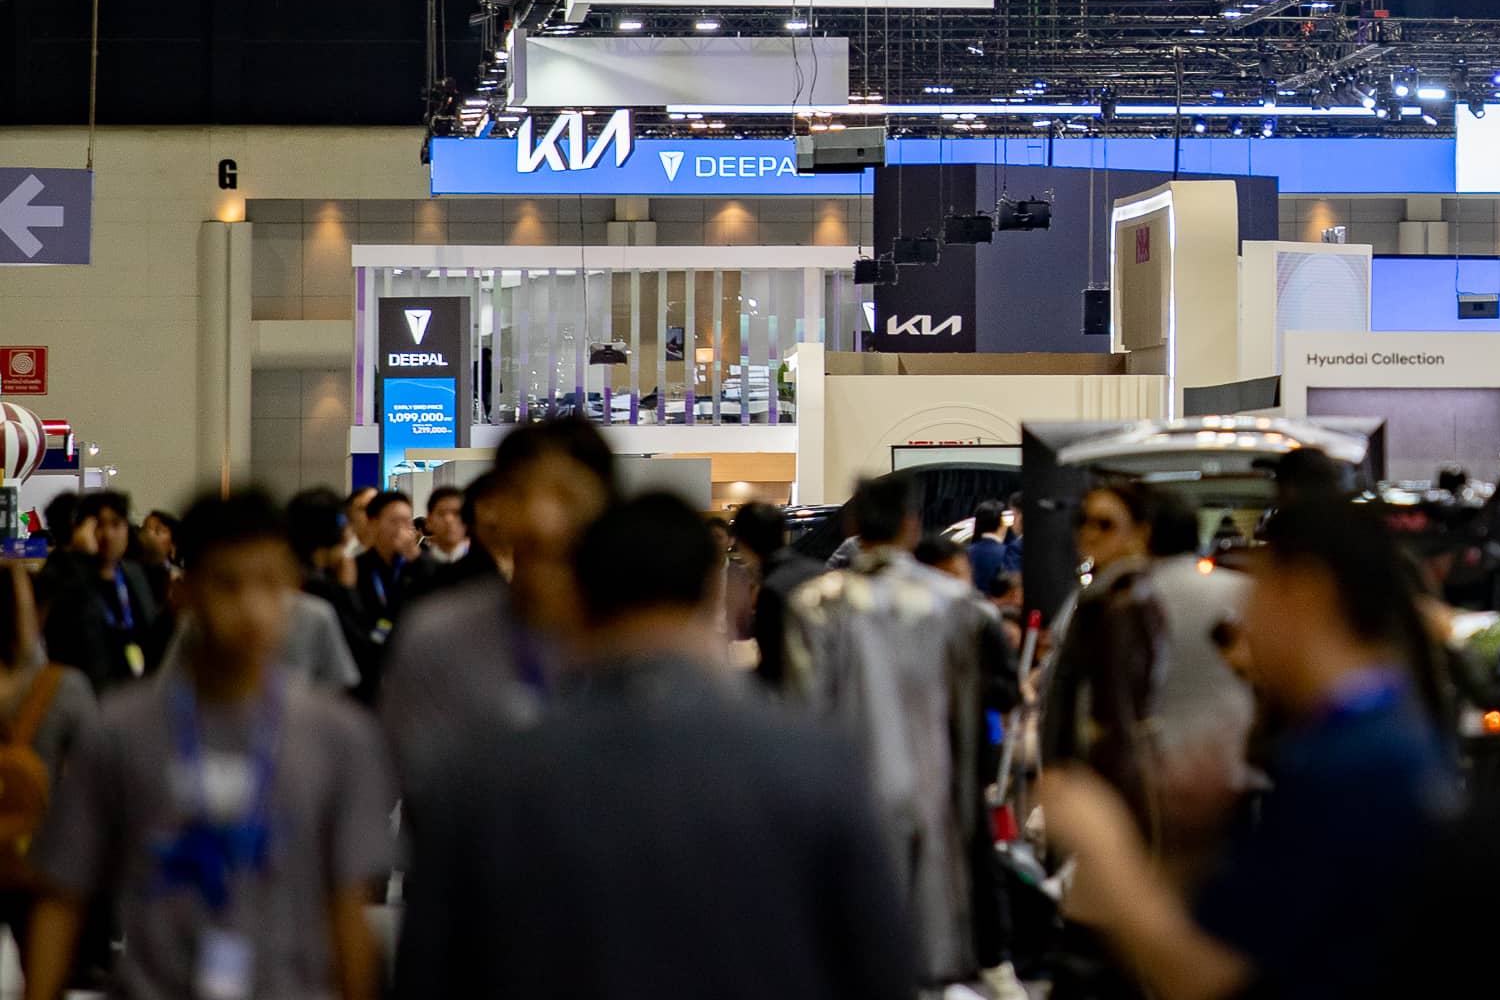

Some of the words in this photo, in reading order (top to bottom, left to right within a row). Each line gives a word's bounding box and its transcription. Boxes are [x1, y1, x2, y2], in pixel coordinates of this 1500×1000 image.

[218, 159, 238, 189] G
[695, 156, 815, 178] DEEPA
[388, 353, 448, 366] DEEPAL
[1306, 352, 1369, 368] Hyundai
[1371, 352, 1446, 366] Collection
[388, 412, 443, 423] 1,099,000
